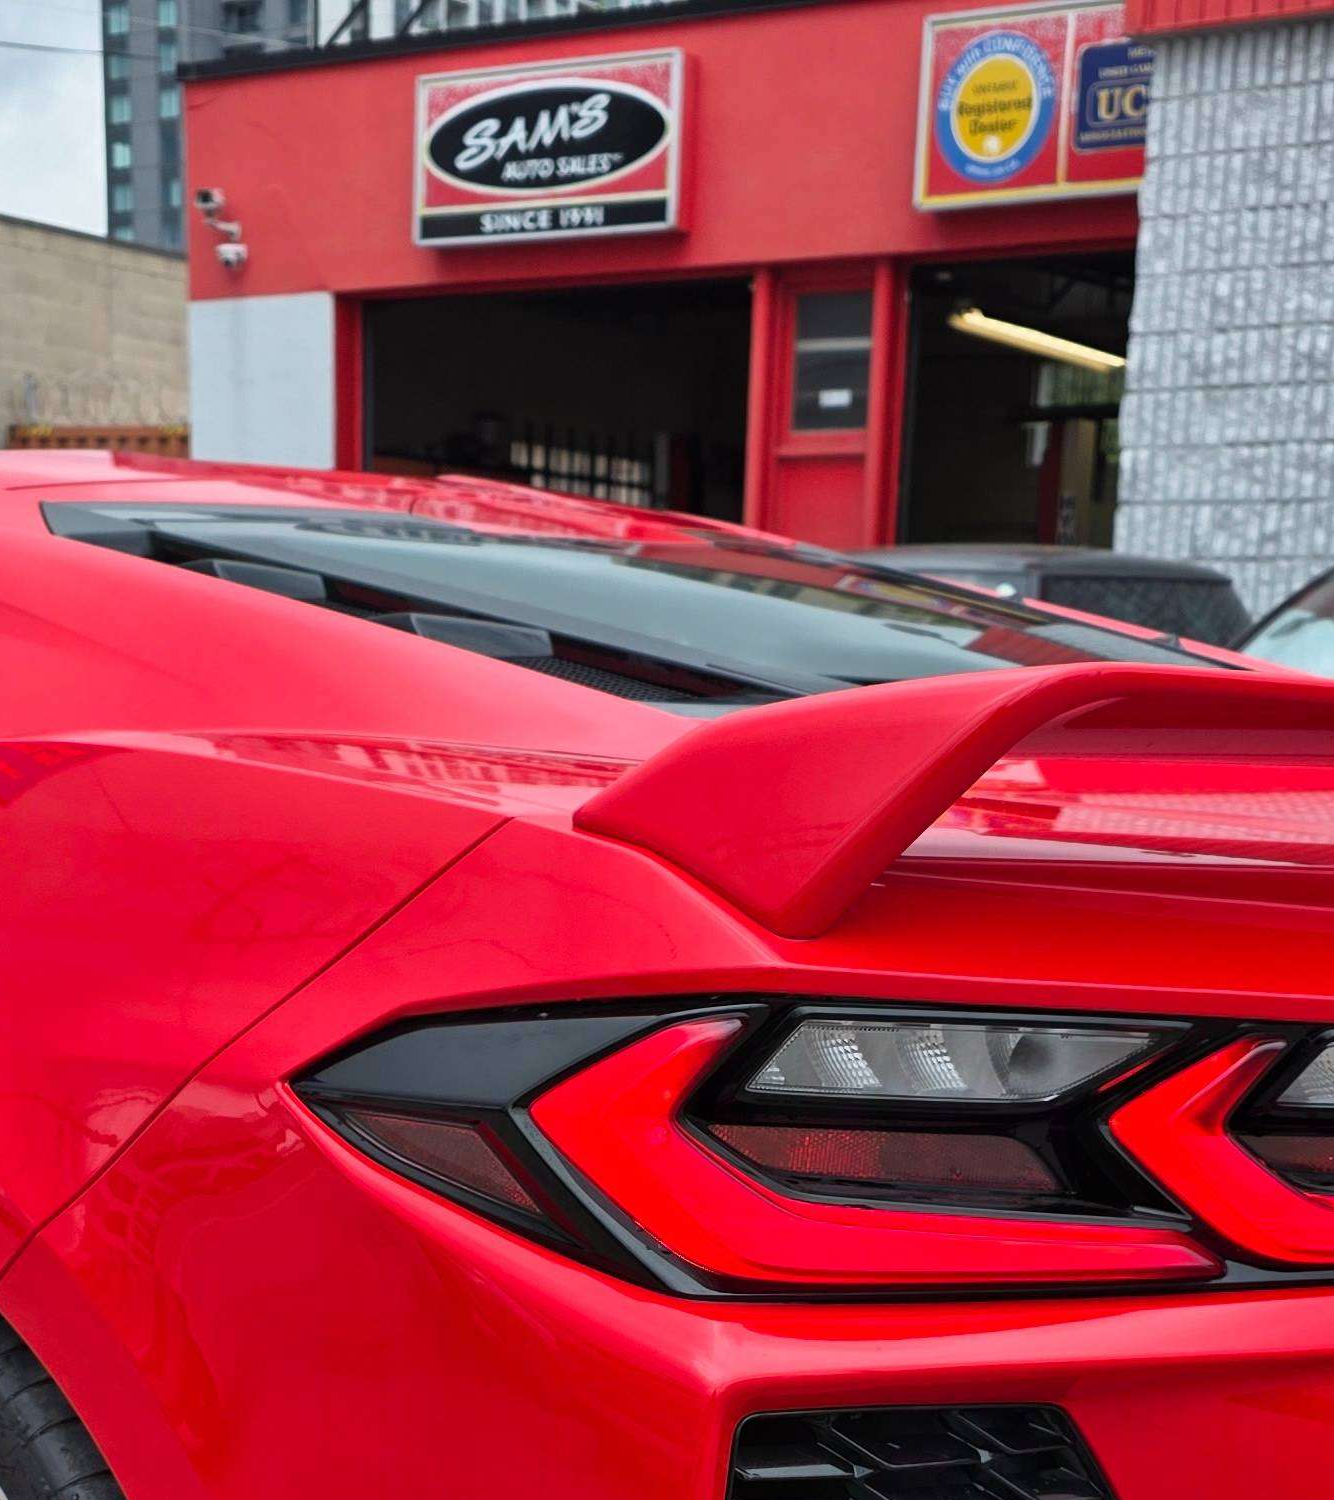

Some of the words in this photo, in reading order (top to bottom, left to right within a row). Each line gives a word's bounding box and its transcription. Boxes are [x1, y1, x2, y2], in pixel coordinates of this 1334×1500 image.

[1096, 84, 1149, 120] UC
[454, 94, 612, 171] SAM'S
[501, 156, 555, 182] AUTO
[555, 152, 613, 176] SALES
[479, 208, 553, 233] SINCE
[558, 205, 605, 229] 1991
